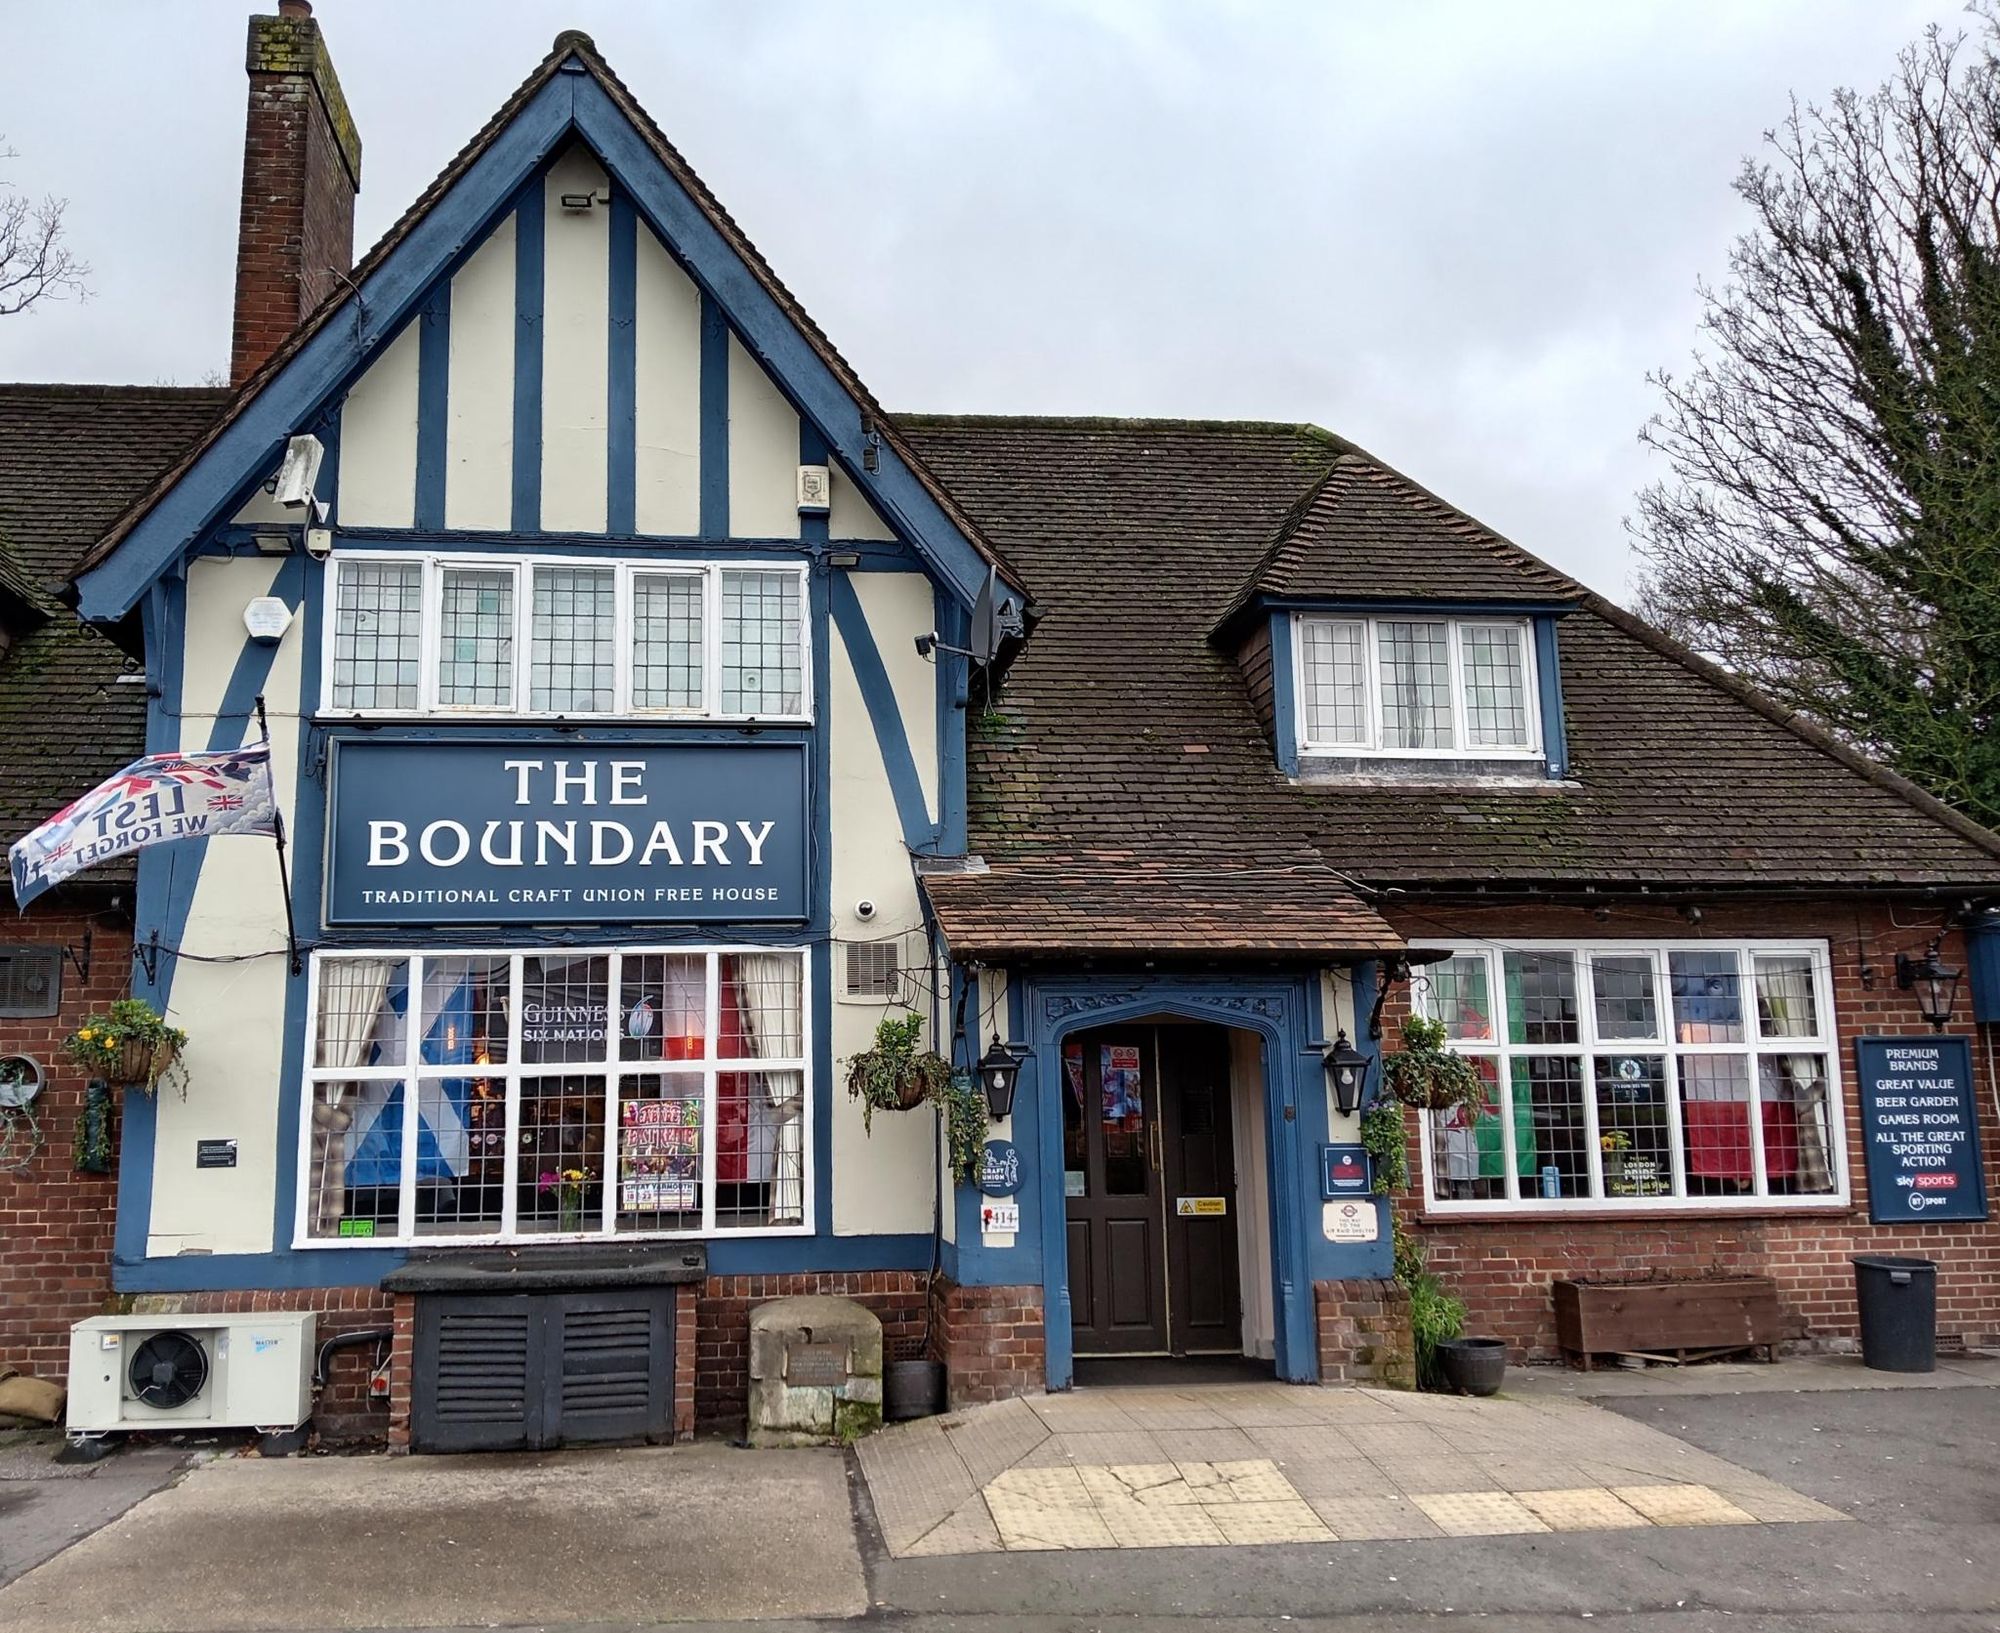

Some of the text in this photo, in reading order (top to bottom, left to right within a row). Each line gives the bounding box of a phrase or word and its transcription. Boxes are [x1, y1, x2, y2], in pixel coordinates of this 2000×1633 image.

[504, 759, 649, 806] THE
[366, 819, 776, 867] BOUNDARY
[362, 887, 779, 904] TRADITIONAL CRAFT UNION FREE HOUSE
[523, 1029, 548, 1042] SIX
[1886, 1048, 1940, 1059] PREMIUM
[1889, 1061, 1939, 1071] BRANDS
[1876, 1079, 1955, 1090] GREAT VALUE
[1876, 1096, 1959, 1107] BEER GARDEN
[1878, 1114, 1960, 1125] GAMES ROOM
[1876, 1131, 1965, 1143] ALL THE GREAT
[1892, 1144, 1953, 1154] SPORTING
[1901, 1156, 1946, 1166] ACTION
[1624, 1168, 1657, 1180] PRIDE
[1896, 1175, 1955, 1188] sky sports
[1911, 1197, 1947, 1205] BT SPORT
[993, 1211, 1015, 1224] 414
